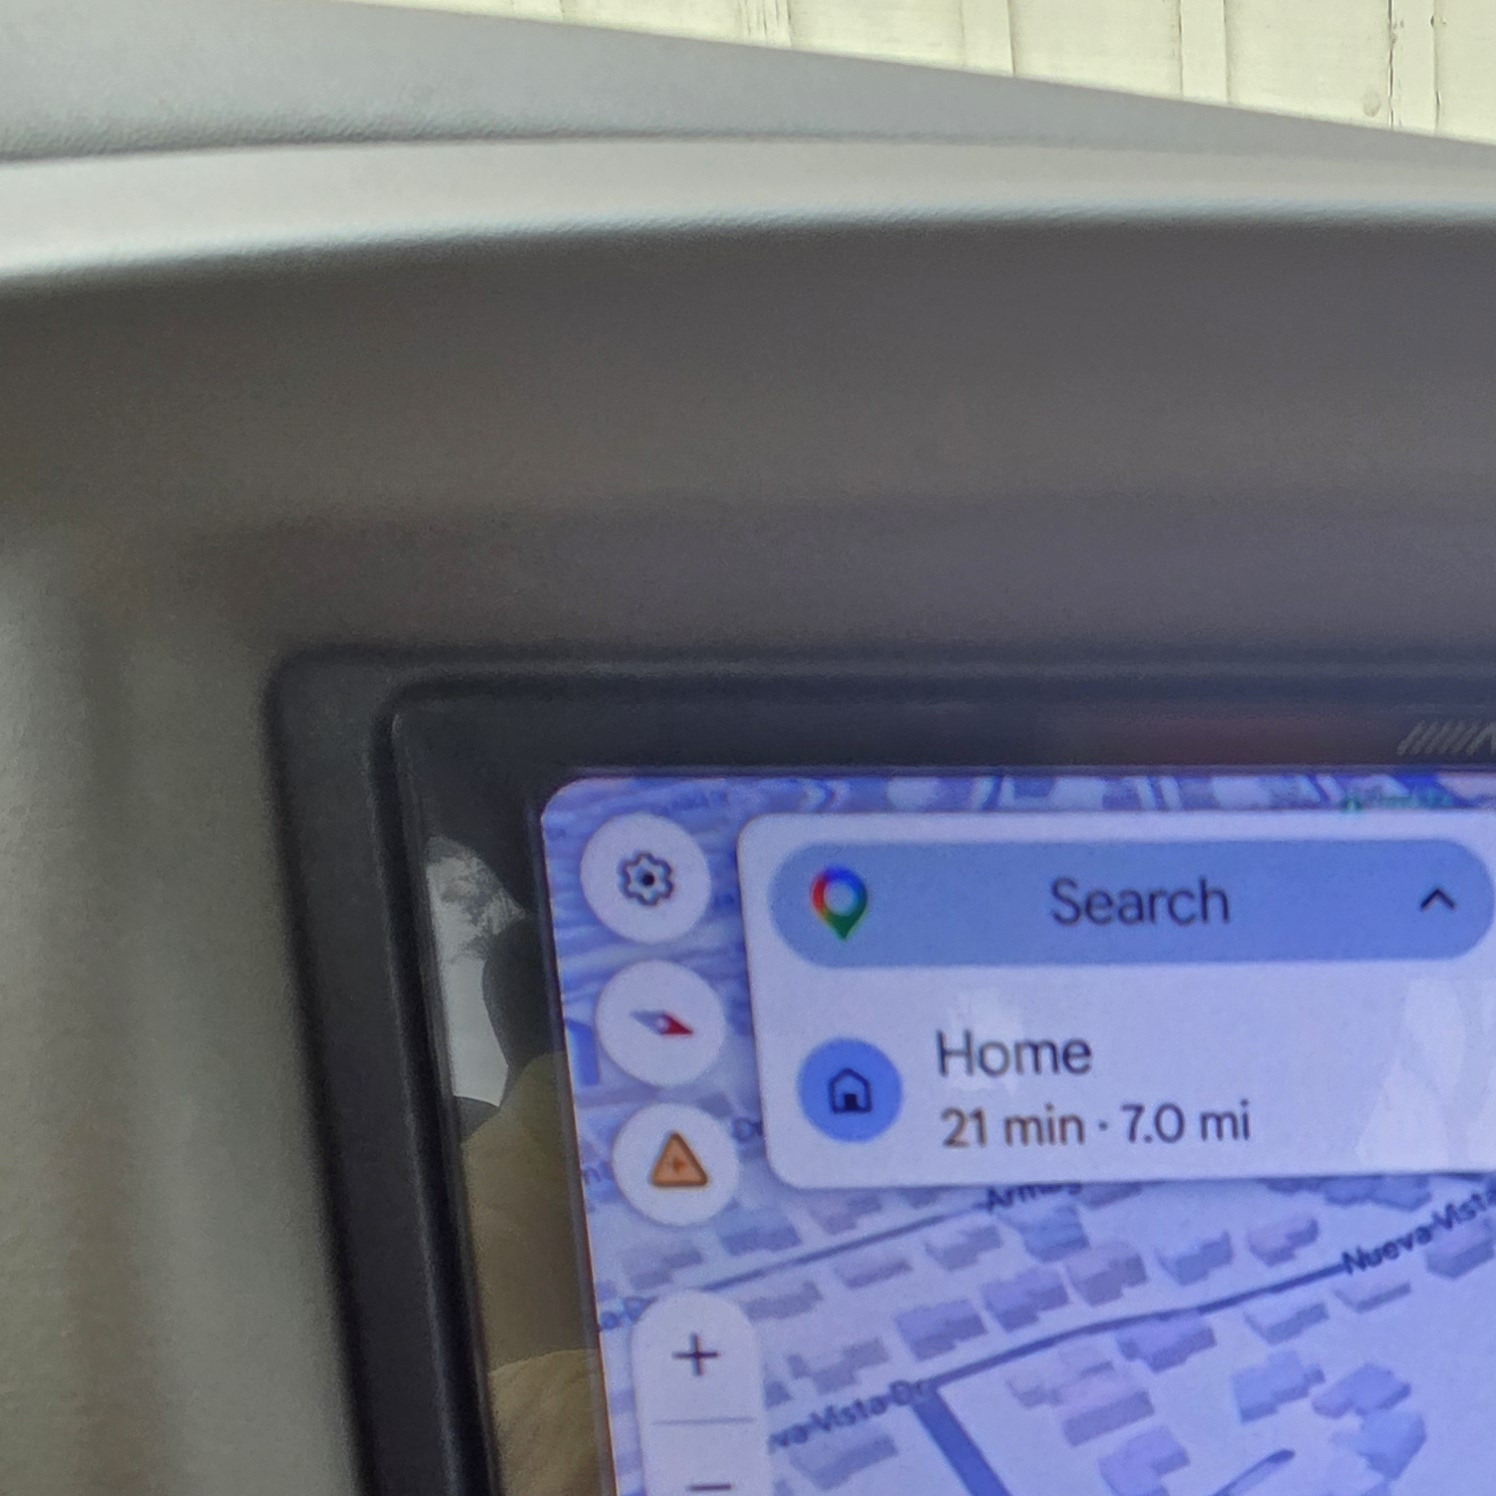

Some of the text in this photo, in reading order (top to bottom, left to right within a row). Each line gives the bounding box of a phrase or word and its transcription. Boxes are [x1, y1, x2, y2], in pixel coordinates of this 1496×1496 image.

[1051, 874, 1230, 926] Search
[936, 1029, 1093, 1077] Home
[942, 1107, 987, 1147] 21
[1004, 1102, 1085, 1146] min
[1121, 1102, 1185, 1144] 7.0
[1200, 1098, 1250, 1141] mi
[1341, 1224, 1433, 1276] Nueva
